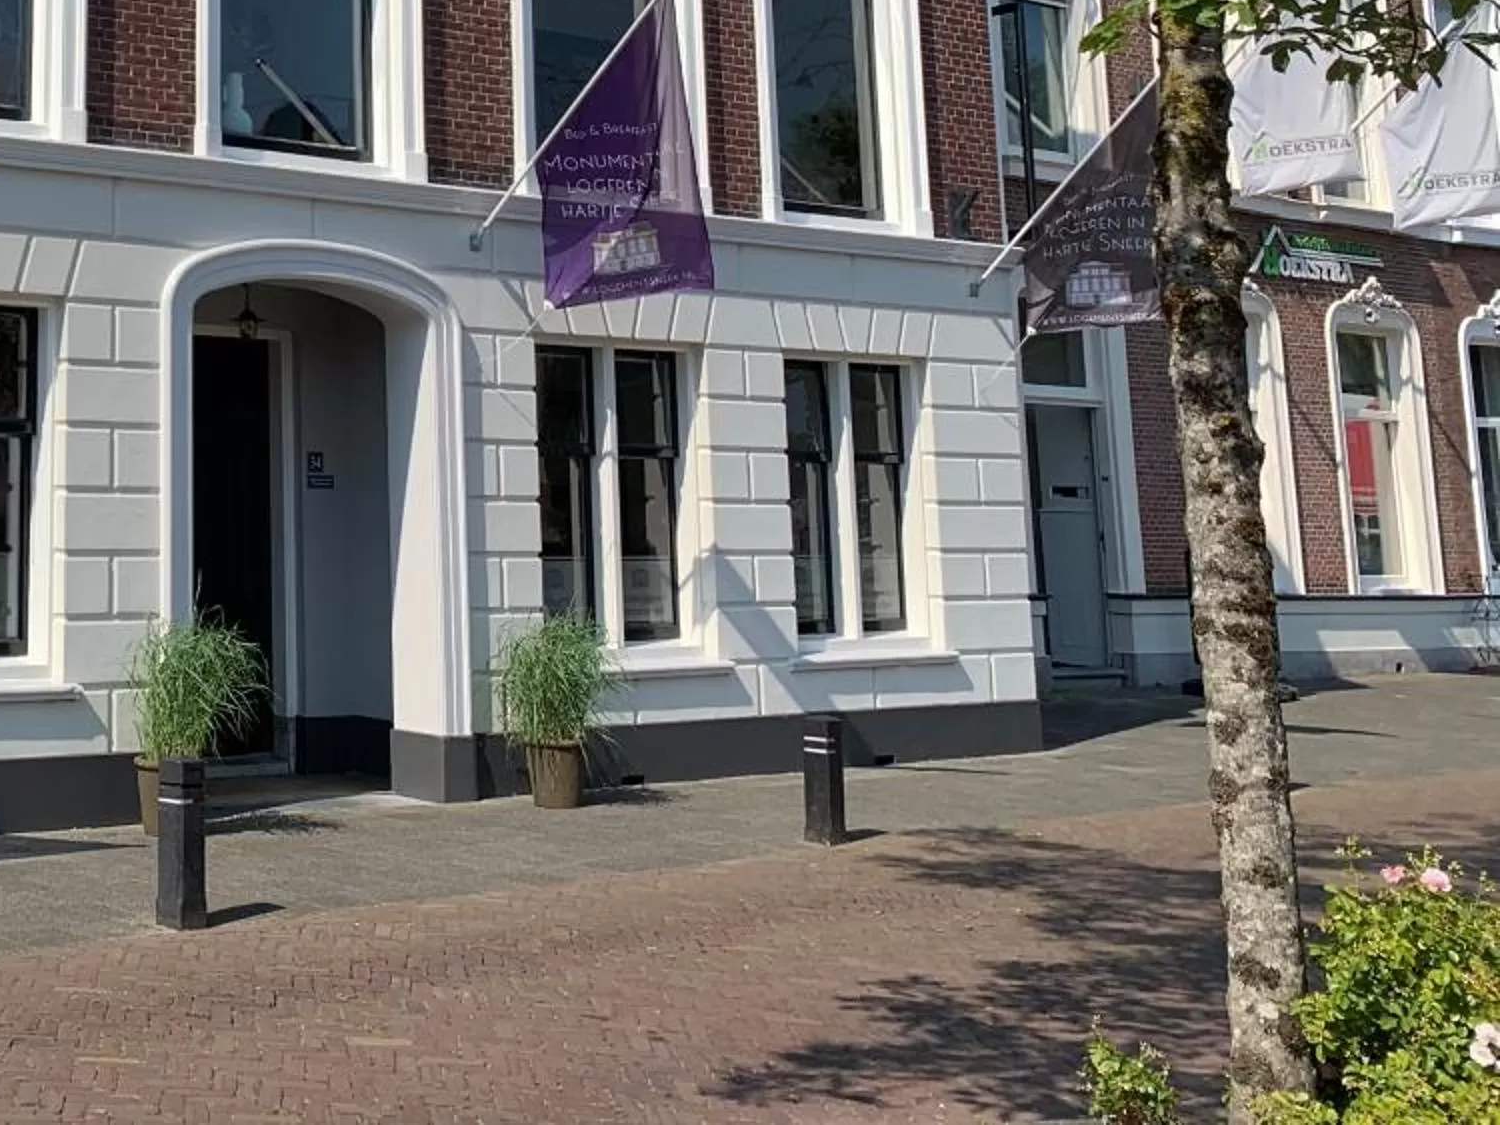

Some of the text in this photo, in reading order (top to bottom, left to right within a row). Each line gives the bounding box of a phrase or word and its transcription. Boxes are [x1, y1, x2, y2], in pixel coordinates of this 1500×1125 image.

[561, 203, 621, 223] HARTJE
[1128, 216, 1145, 228] IN
[1263, 244, 1354, 283] HOEKSTRA
